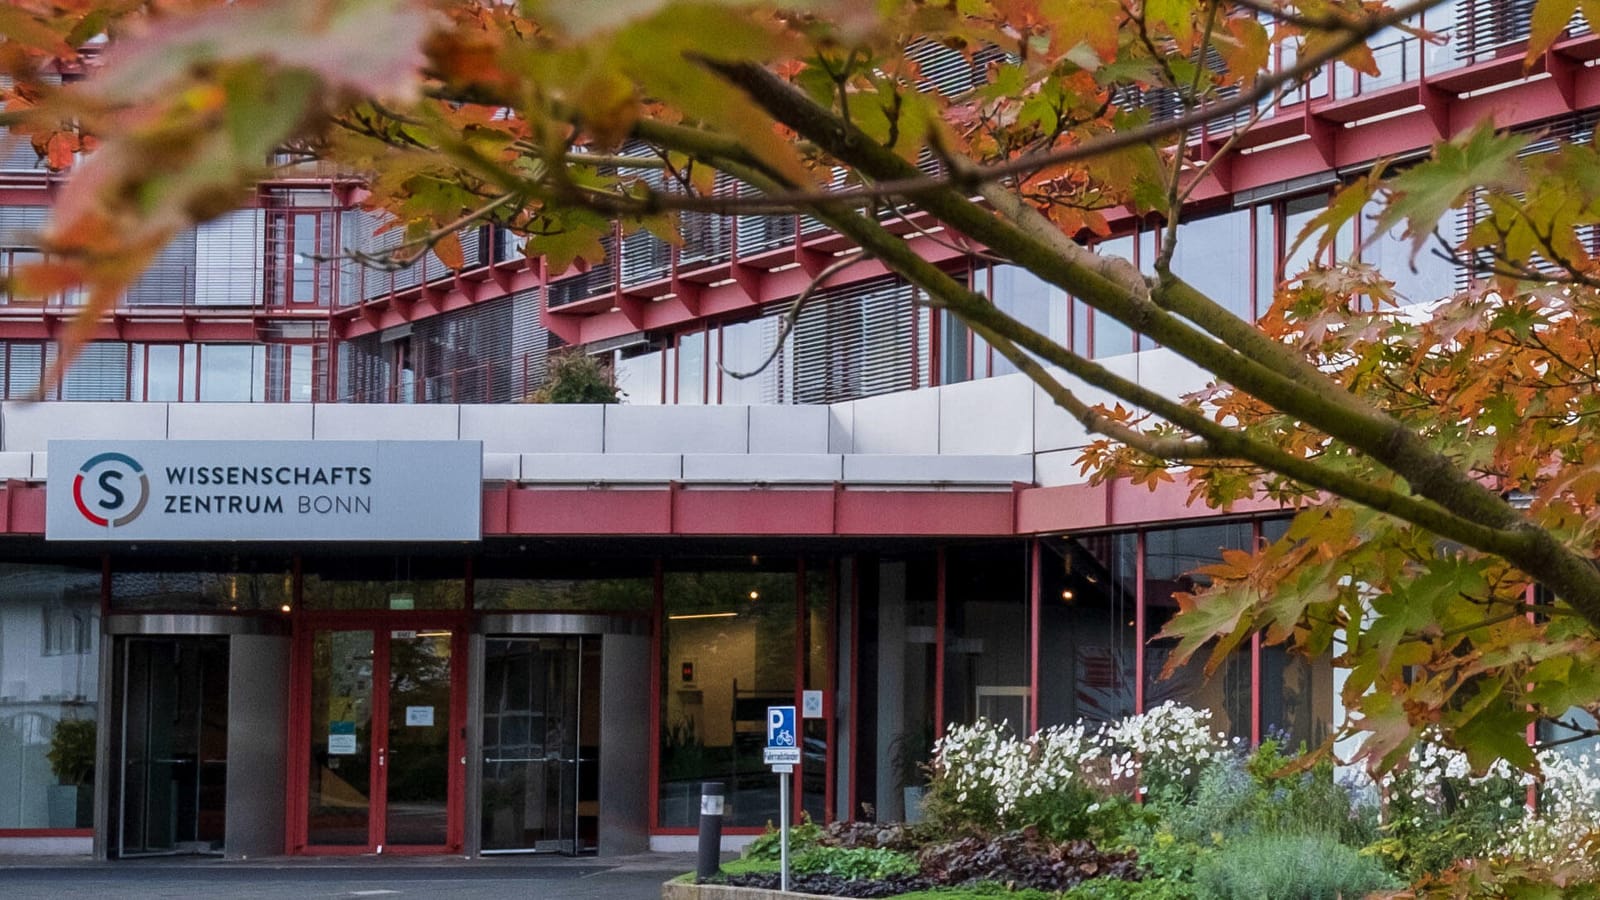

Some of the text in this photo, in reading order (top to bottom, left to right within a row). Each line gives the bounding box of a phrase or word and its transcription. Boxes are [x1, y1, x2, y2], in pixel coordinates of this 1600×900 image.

[165, 466, 372, 486] WISSENSCHAFTS
[98, 469, 125, 511] S
[164, 495, 372, 515] ZENTRUM BONN
[769, 709, 784, 740] P
